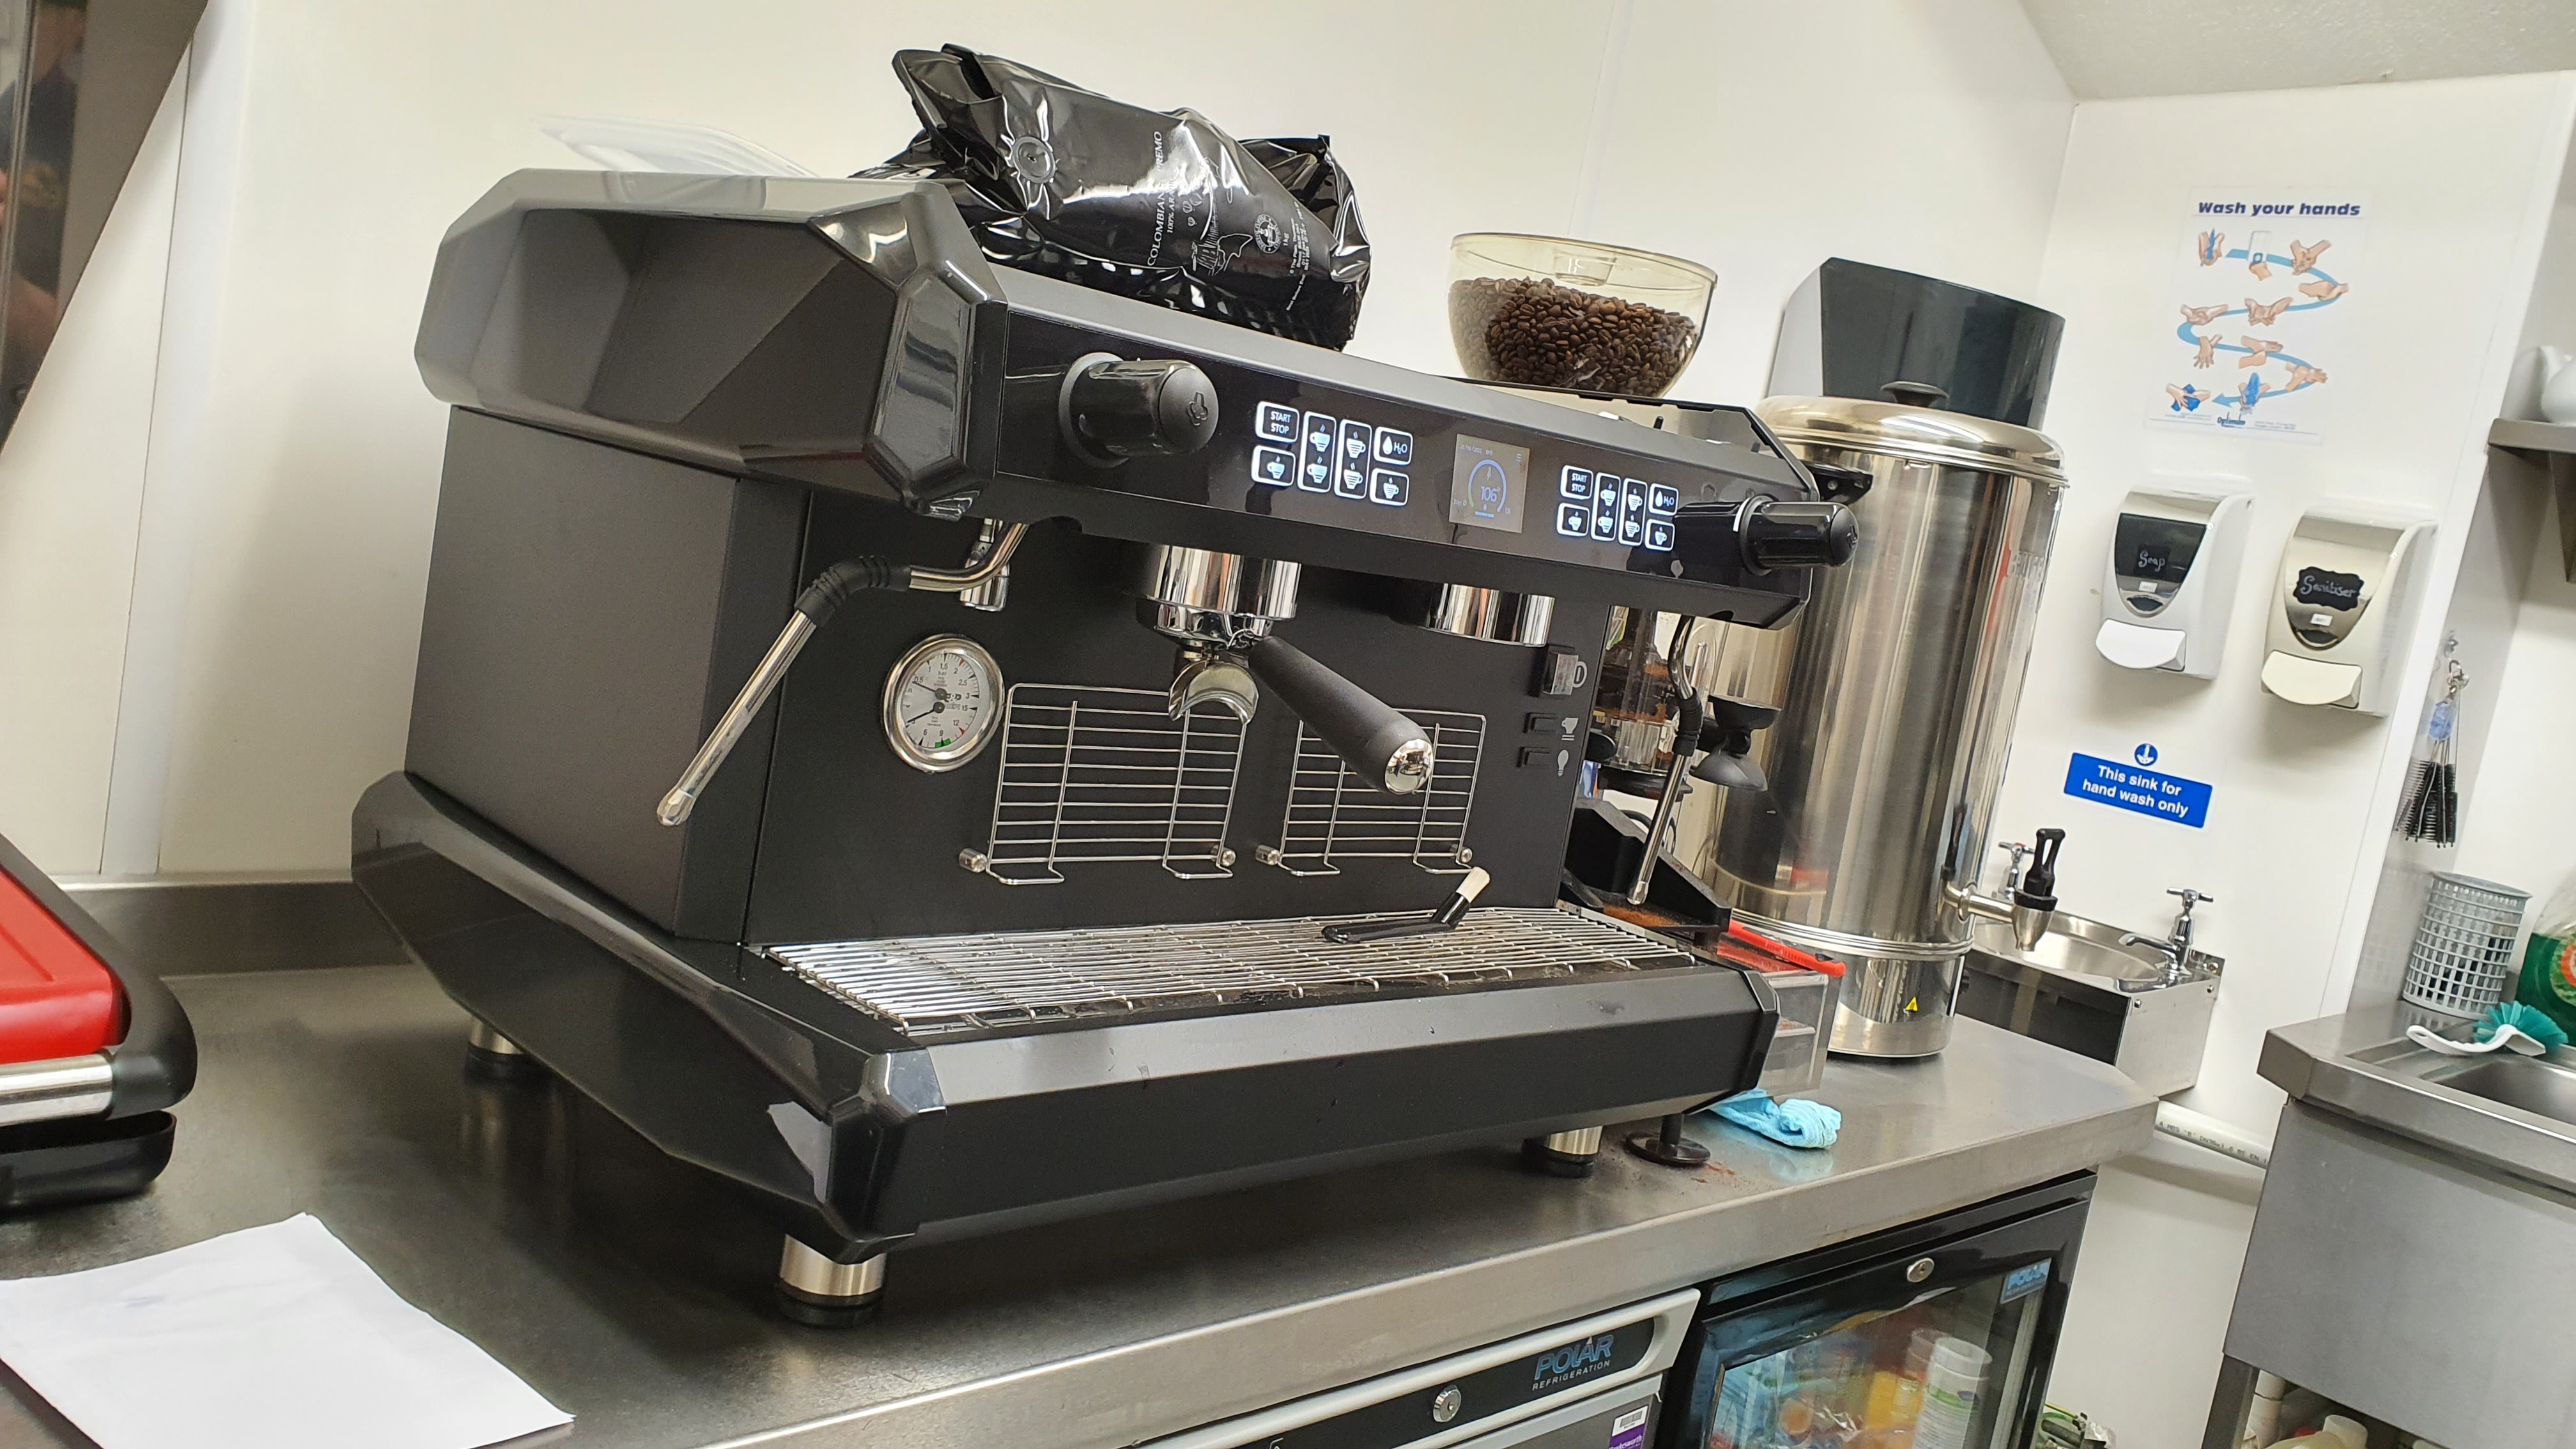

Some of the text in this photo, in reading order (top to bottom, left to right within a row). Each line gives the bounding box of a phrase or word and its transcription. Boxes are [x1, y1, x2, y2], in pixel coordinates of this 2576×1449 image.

[2198, 202, 2361, 217] Wash your hands
[1147, 191, 1165, 266] COLOMBIAN
[1167, 211, 1175, 234] 100%
[1271, 411, 1291, 423] START
[1271, 423, 1289, 434] STOP
[1394, 441, 1407, 454] H2O
[1572, 473, 1588, 483] START
[1572, 484, 1586, 493] STOP
[1481, 486, 1501, 502] 106°
[2138, 550, 2166, 572] Soap
[2300, 575, 2356, 599] Sanitiser
[2098, 765, 2182, 796] This sink for
[2082, 778, 2189, 818] hand wash only
[1534, 1335, 1614, 1380] POLAR
[1532, 1360, 1611, 1391] REFRIGERATION
